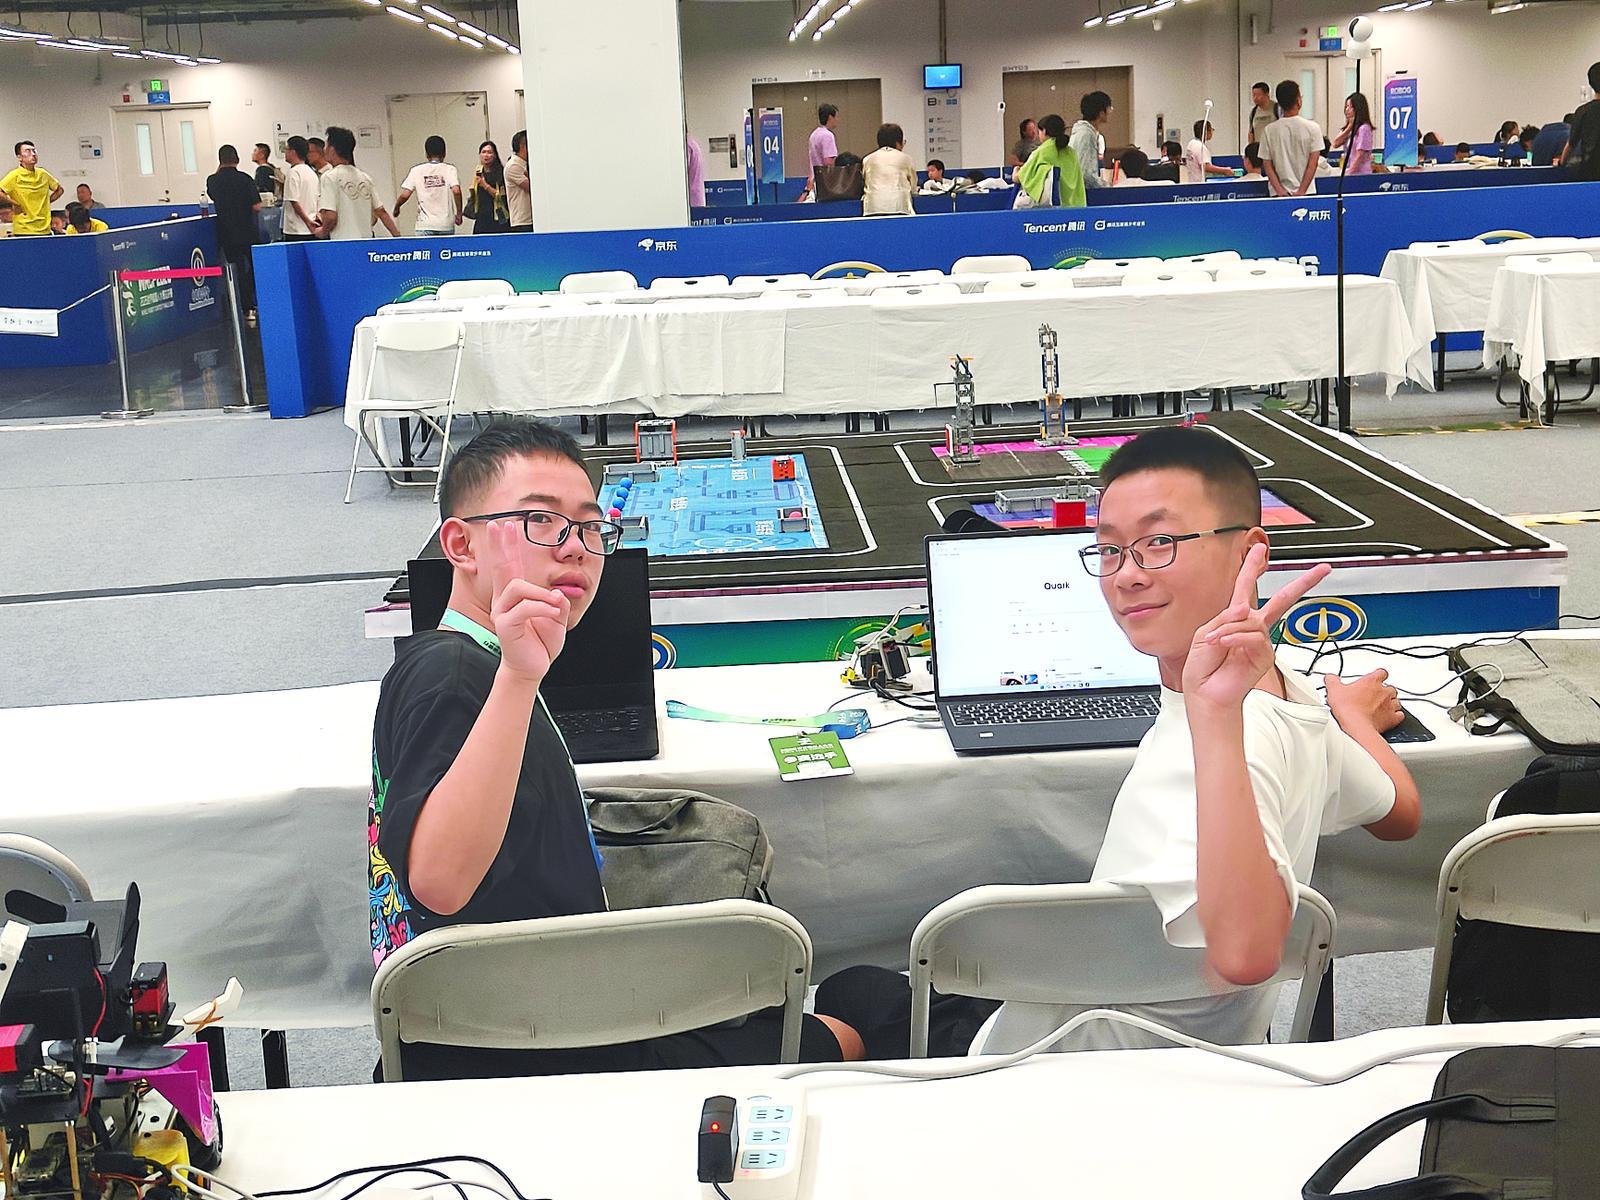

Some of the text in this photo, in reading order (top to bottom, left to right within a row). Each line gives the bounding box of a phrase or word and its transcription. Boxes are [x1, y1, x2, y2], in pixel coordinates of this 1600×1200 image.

[1389, 106, 1412, 130] 07
[763, 135, 780, 154] 04
[1308, 210, 1331, 221] 京东
[1023, 222, 1067, 234] Tencent
[655, 240, 678, 252] 京东
[367, 251, 412, 263] Tencent
[1043, 581, 1070, 590] Quark
